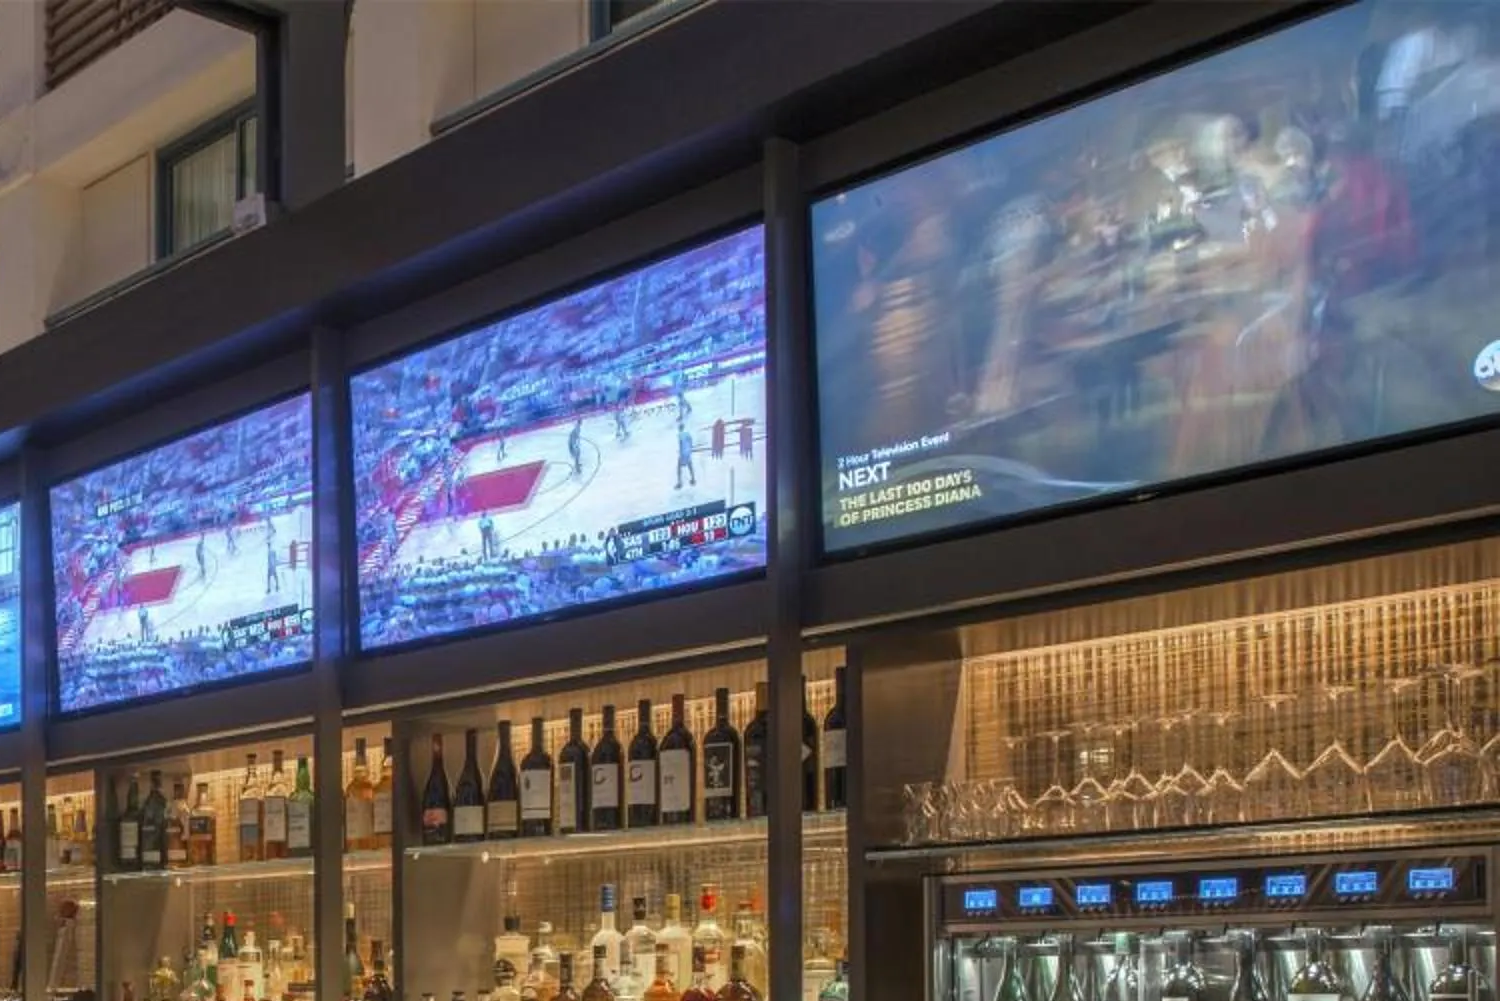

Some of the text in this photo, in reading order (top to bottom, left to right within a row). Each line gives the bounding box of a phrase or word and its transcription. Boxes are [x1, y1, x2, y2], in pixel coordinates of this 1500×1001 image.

[871, 439, 919, 459] Television
[921, 432, 950, 447] Event
[839, 461, 891, 490] NEXT
[839, 469, 974, 512] THE LAST 100 DAYS
[839, 484, 982, 527] OF PRINCESS DIANA
